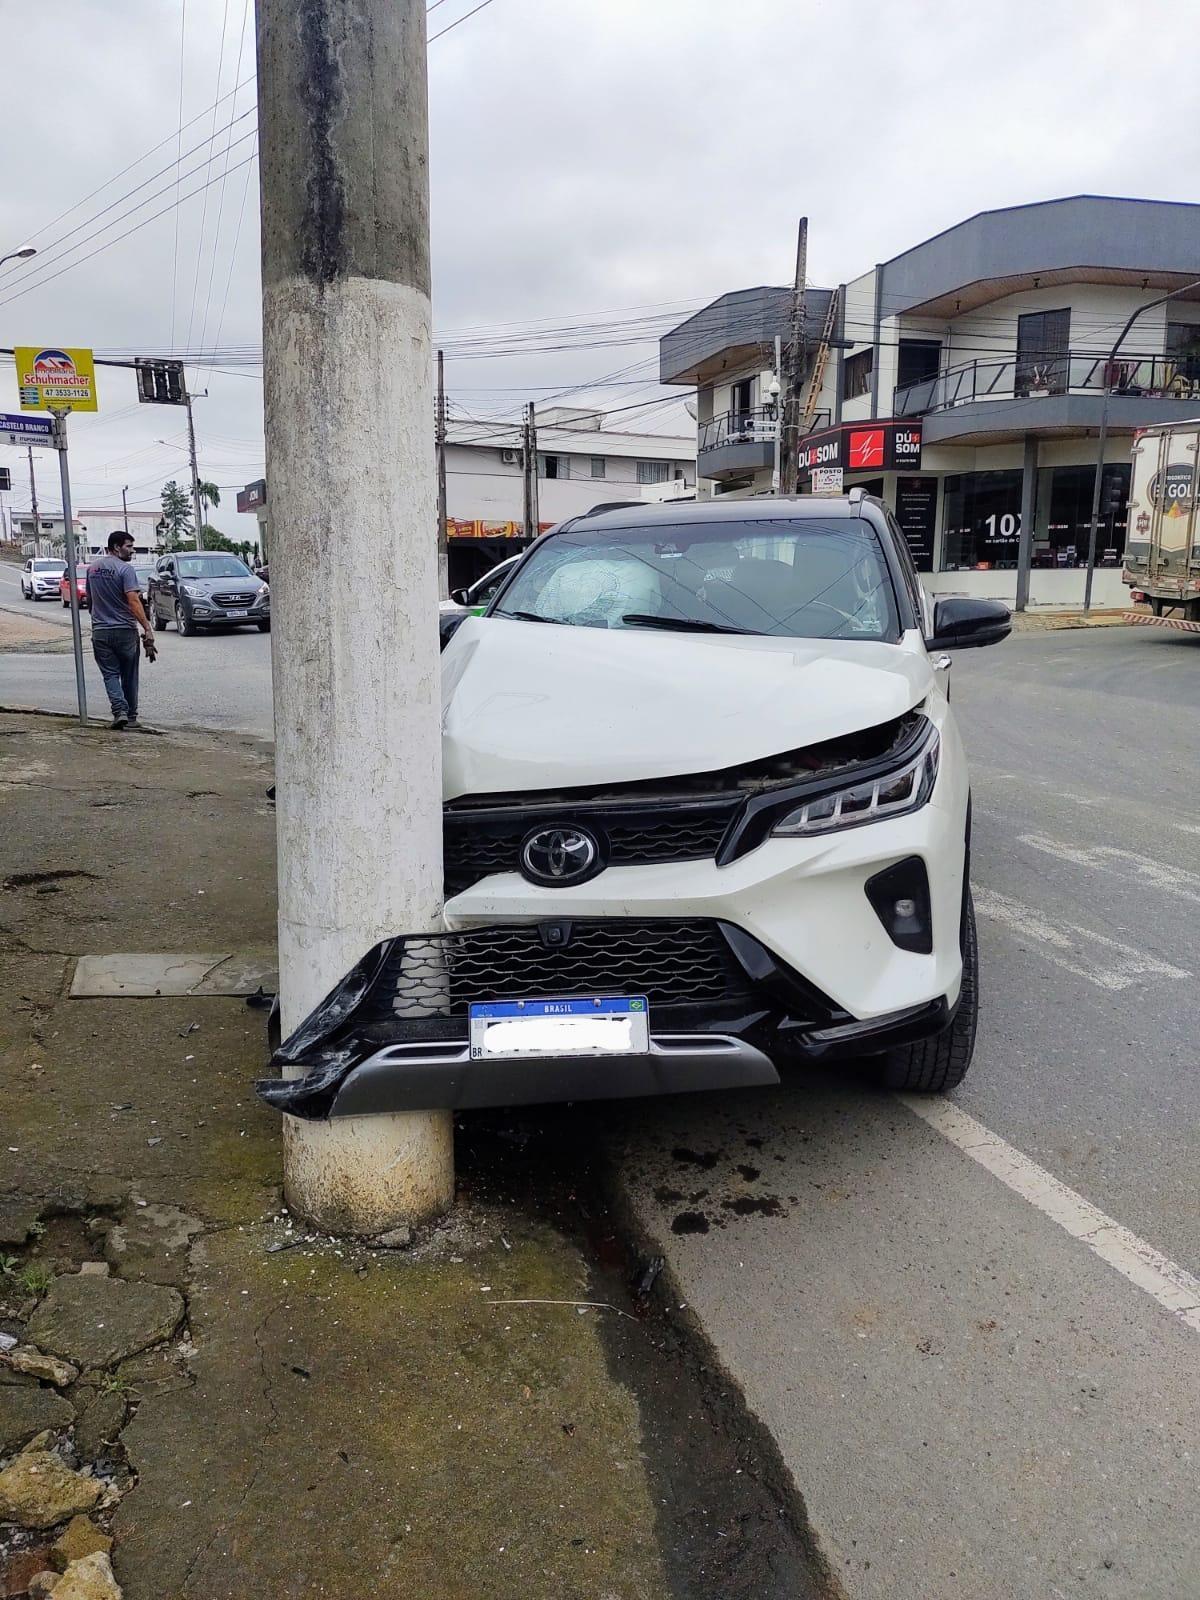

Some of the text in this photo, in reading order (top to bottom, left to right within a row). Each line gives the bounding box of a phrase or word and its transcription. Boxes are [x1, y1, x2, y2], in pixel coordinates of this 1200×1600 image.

[24, 374, 89, 385] Schuhmacher
[55, 389, 89, 397] 3533-1126
[25, 424, 49, 432] BRANCO
[896, 430, 912, 443] DÚ
[896, 443, 920, 453] SOM
[544, 1005, 573, 1013] BRASIL
[472, 1047, 483, 1058] BR
